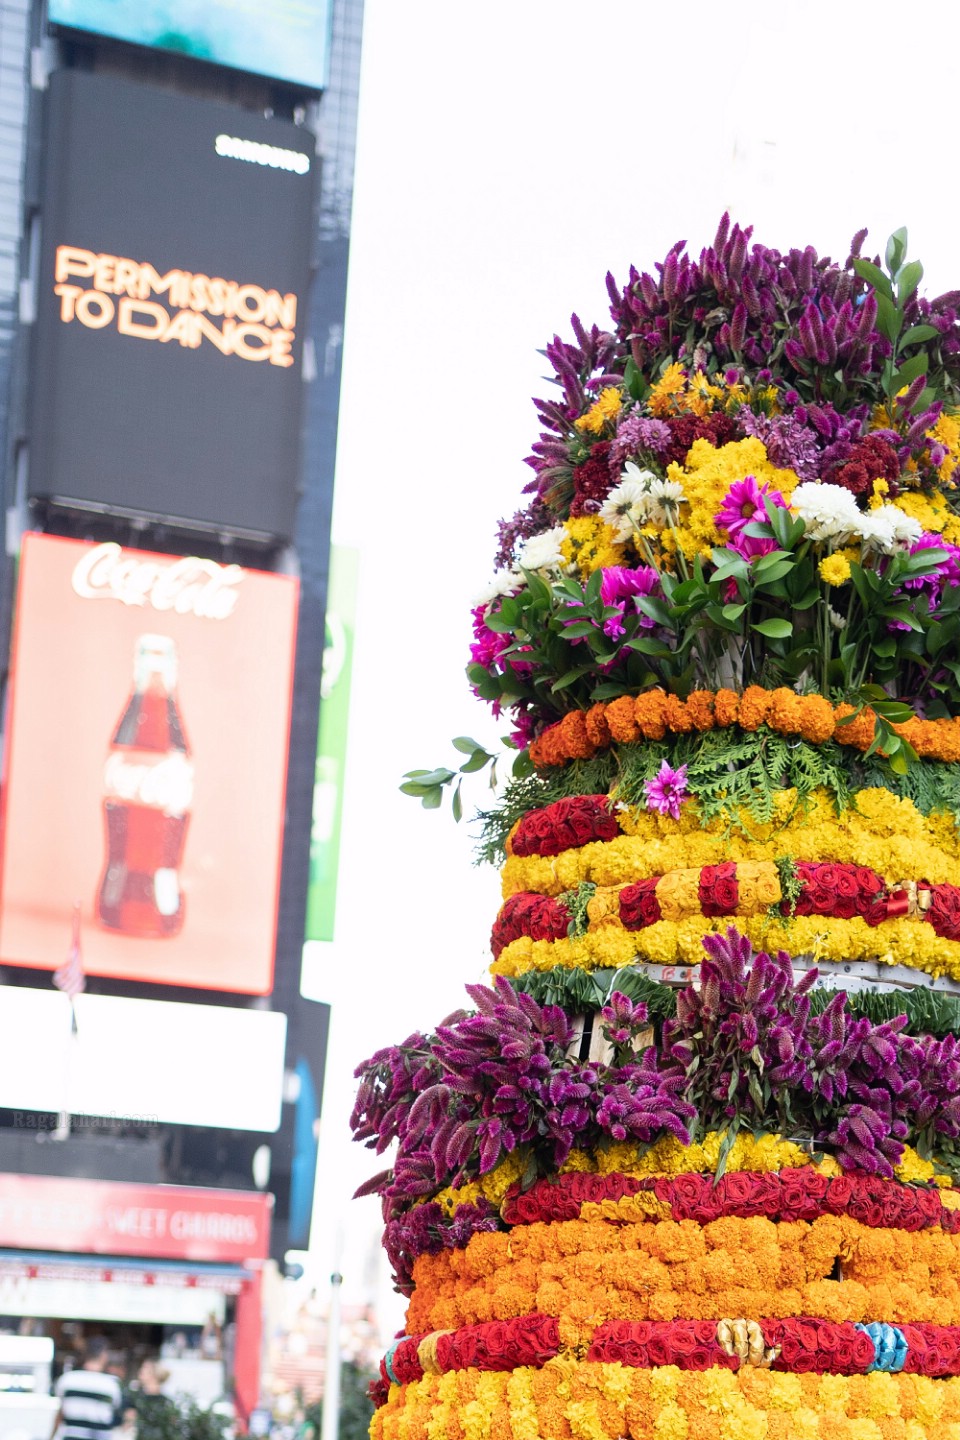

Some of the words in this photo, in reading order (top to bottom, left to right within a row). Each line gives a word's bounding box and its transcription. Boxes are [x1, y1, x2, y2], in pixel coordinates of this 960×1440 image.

[54, 283, 115, 329] TO
[118, 297, 295, 367] DANCE
[55, 245, 297, 330] PERMISSION
